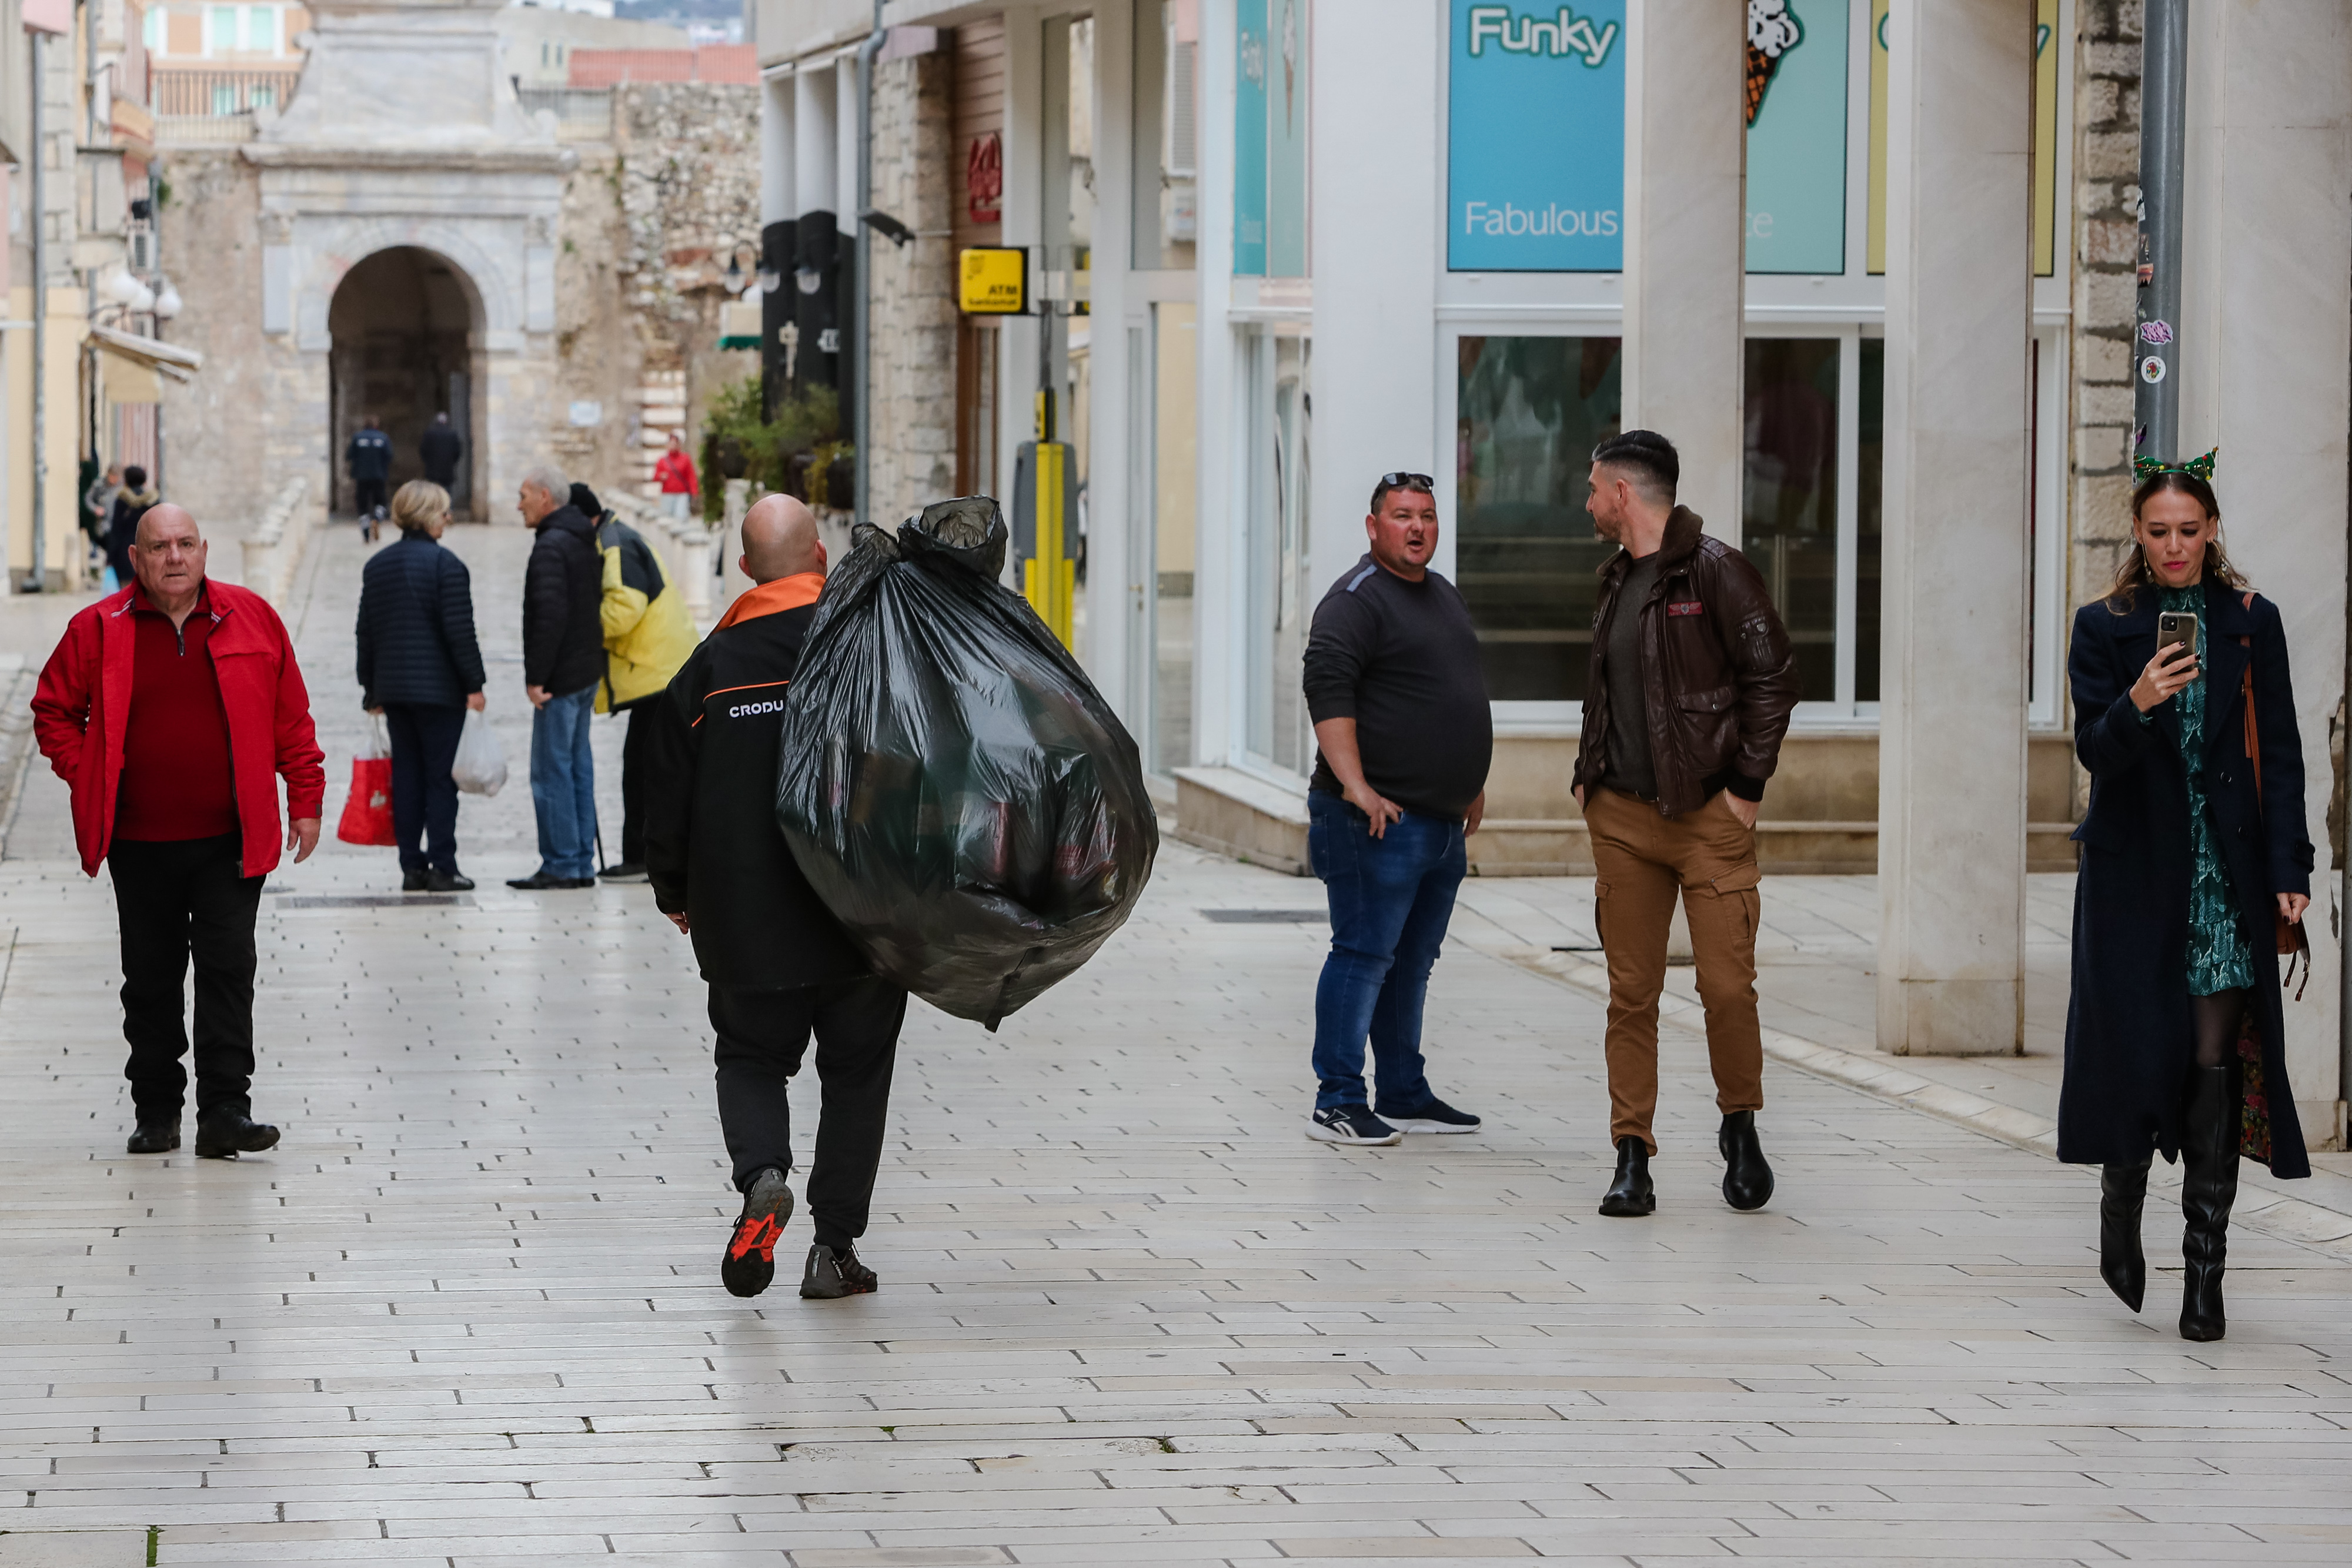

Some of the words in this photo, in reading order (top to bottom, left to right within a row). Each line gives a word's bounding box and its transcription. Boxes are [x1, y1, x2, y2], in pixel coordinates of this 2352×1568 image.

[1470, 6, 1617, 66] Funky
[1466, 201, 1618, 235] Fabulous
[988, 285, 1017, 295] ATM
[729, 699, 784, 718] CRODU
